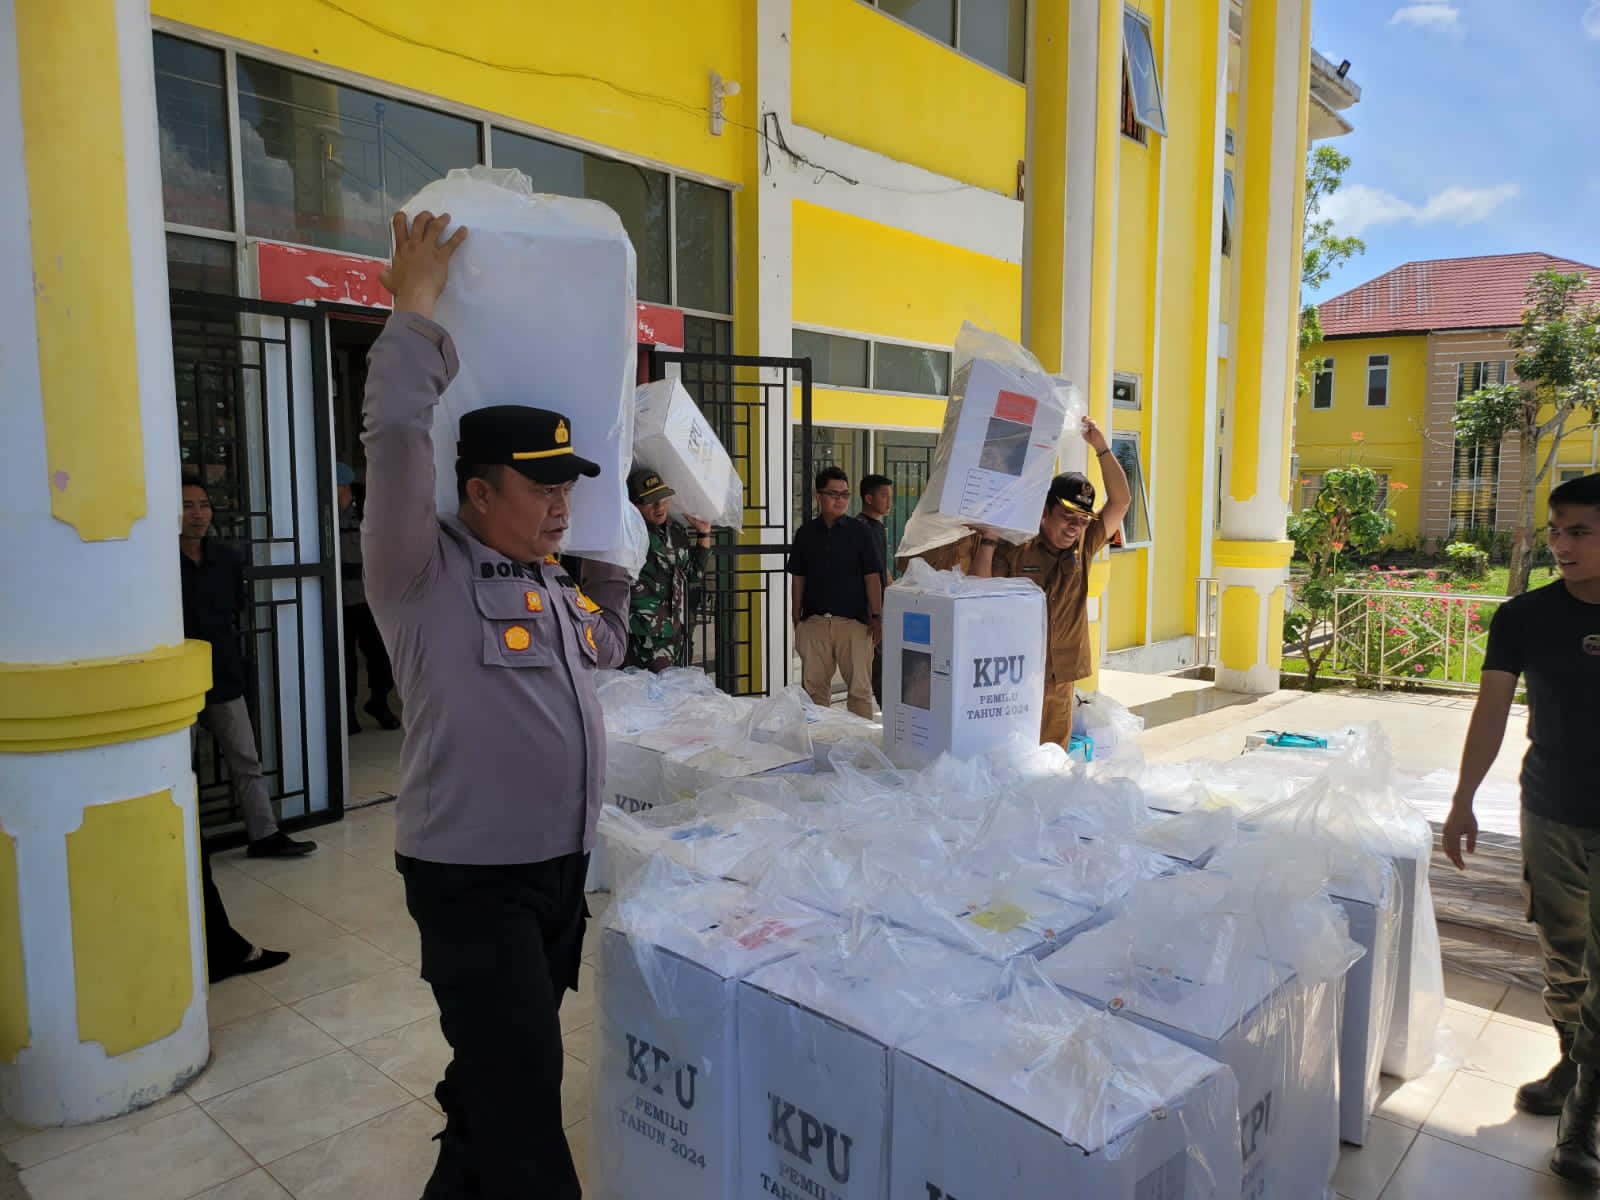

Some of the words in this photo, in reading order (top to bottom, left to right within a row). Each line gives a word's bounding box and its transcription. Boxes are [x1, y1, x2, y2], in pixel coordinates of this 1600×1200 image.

[973, 655, 1025, 688] KPU
[966, 707, 1003, 719] TAHUN
[634, 1096, 689, 1136] PEMILU
[619, 1107, 666, 1145] TAHUN
[670, 1138, 707, 1169] 2024
[767, 1090, 853, 1184] KPU
